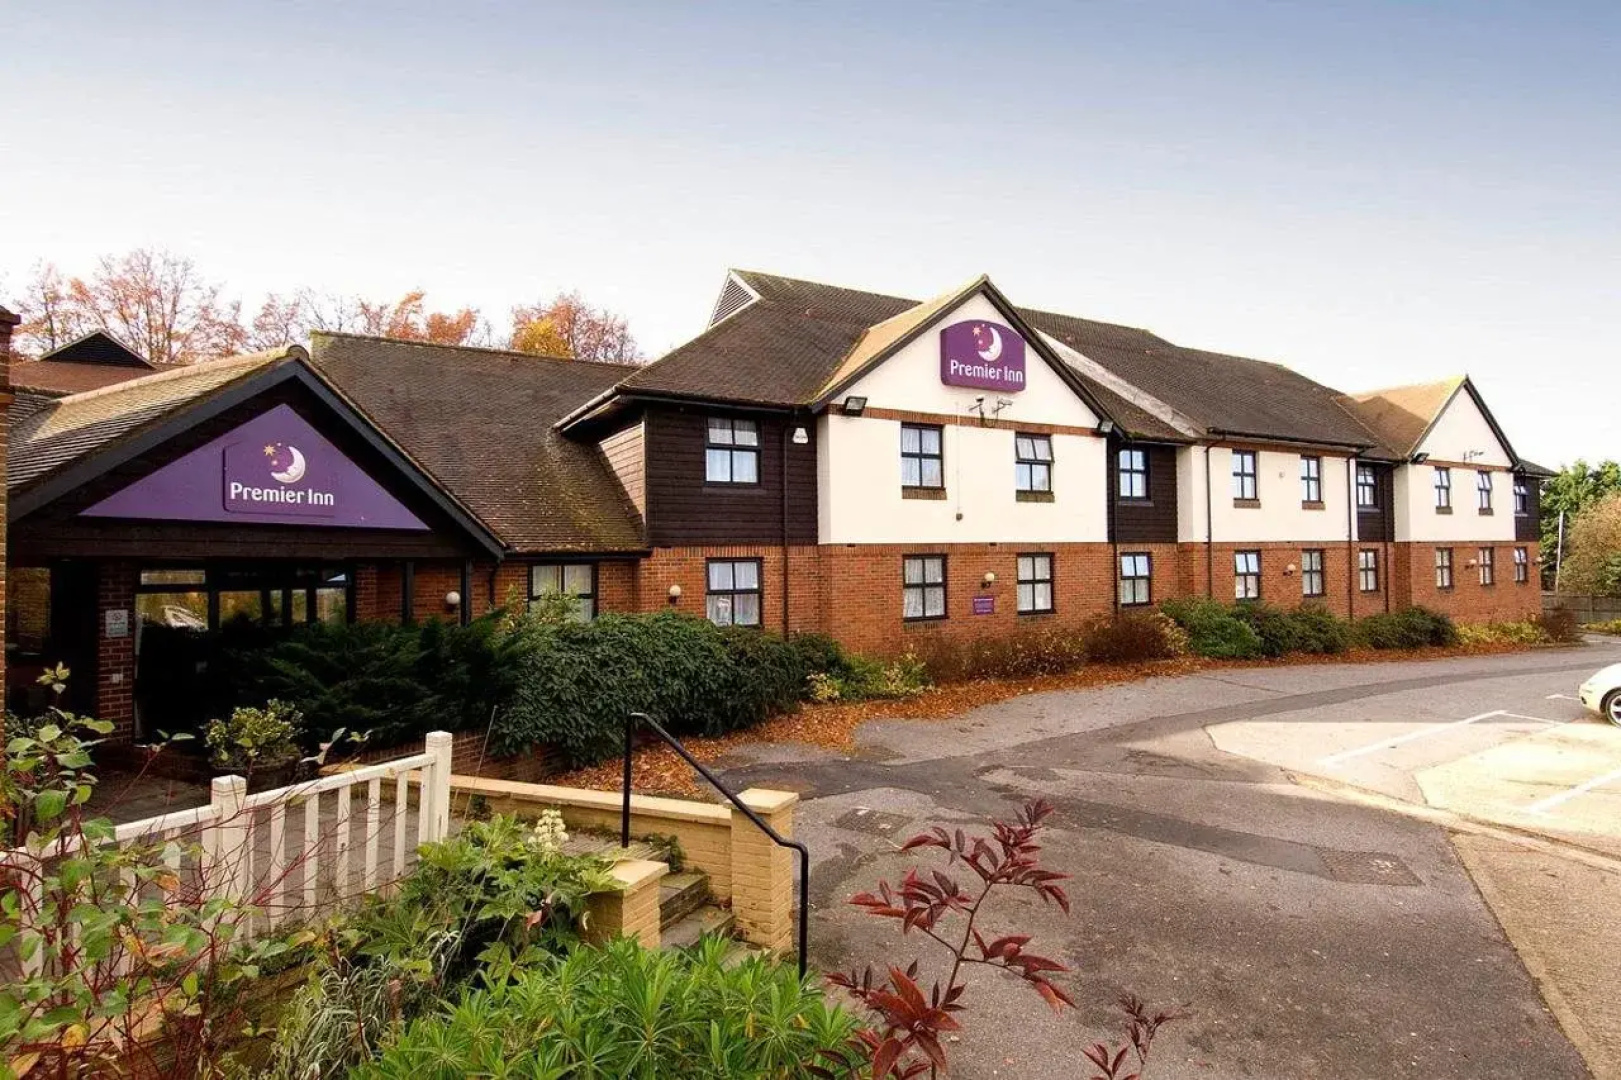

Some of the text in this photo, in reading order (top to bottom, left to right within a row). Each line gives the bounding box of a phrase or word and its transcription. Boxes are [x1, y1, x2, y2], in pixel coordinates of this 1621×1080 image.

[950, 360, 1023, 382] Premier Inn
[230, 482, 334, 506] Premier Inn
